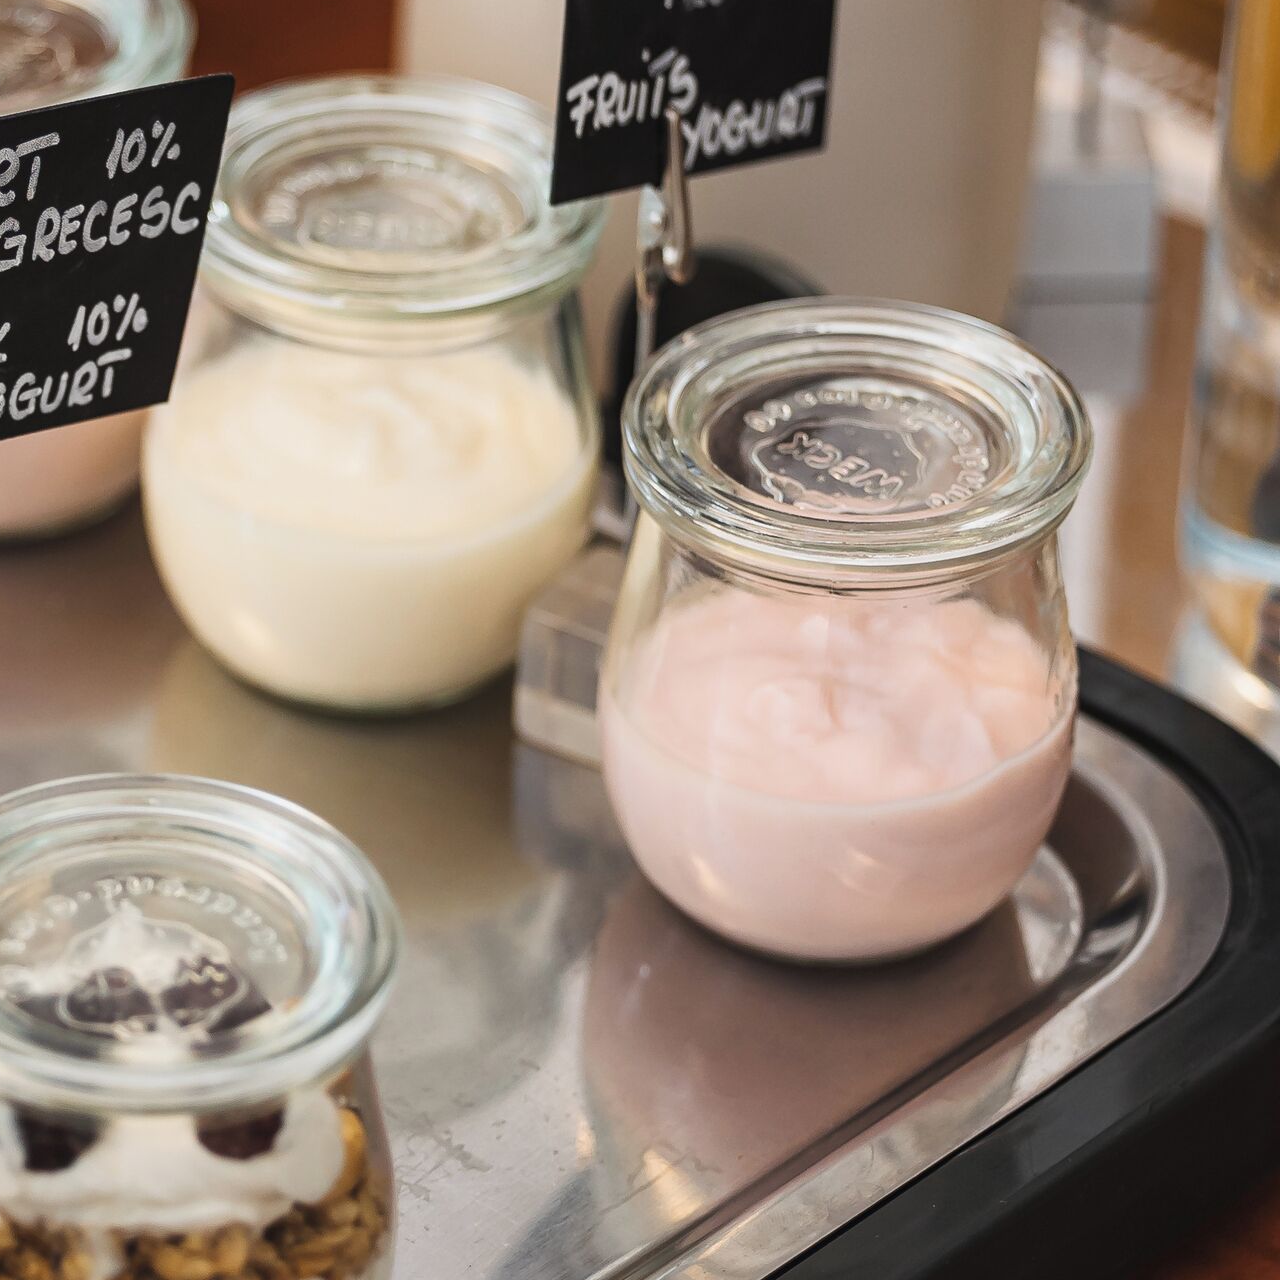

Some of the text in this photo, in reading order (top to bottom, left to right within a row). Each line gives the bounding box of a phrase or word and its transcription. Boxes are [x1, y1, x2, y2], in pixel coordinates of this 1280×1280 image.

[104, 119, 182, 180] 10%
[681, 76, 826, 171] YOGURT
[66, 292, 149, 353] 10%
